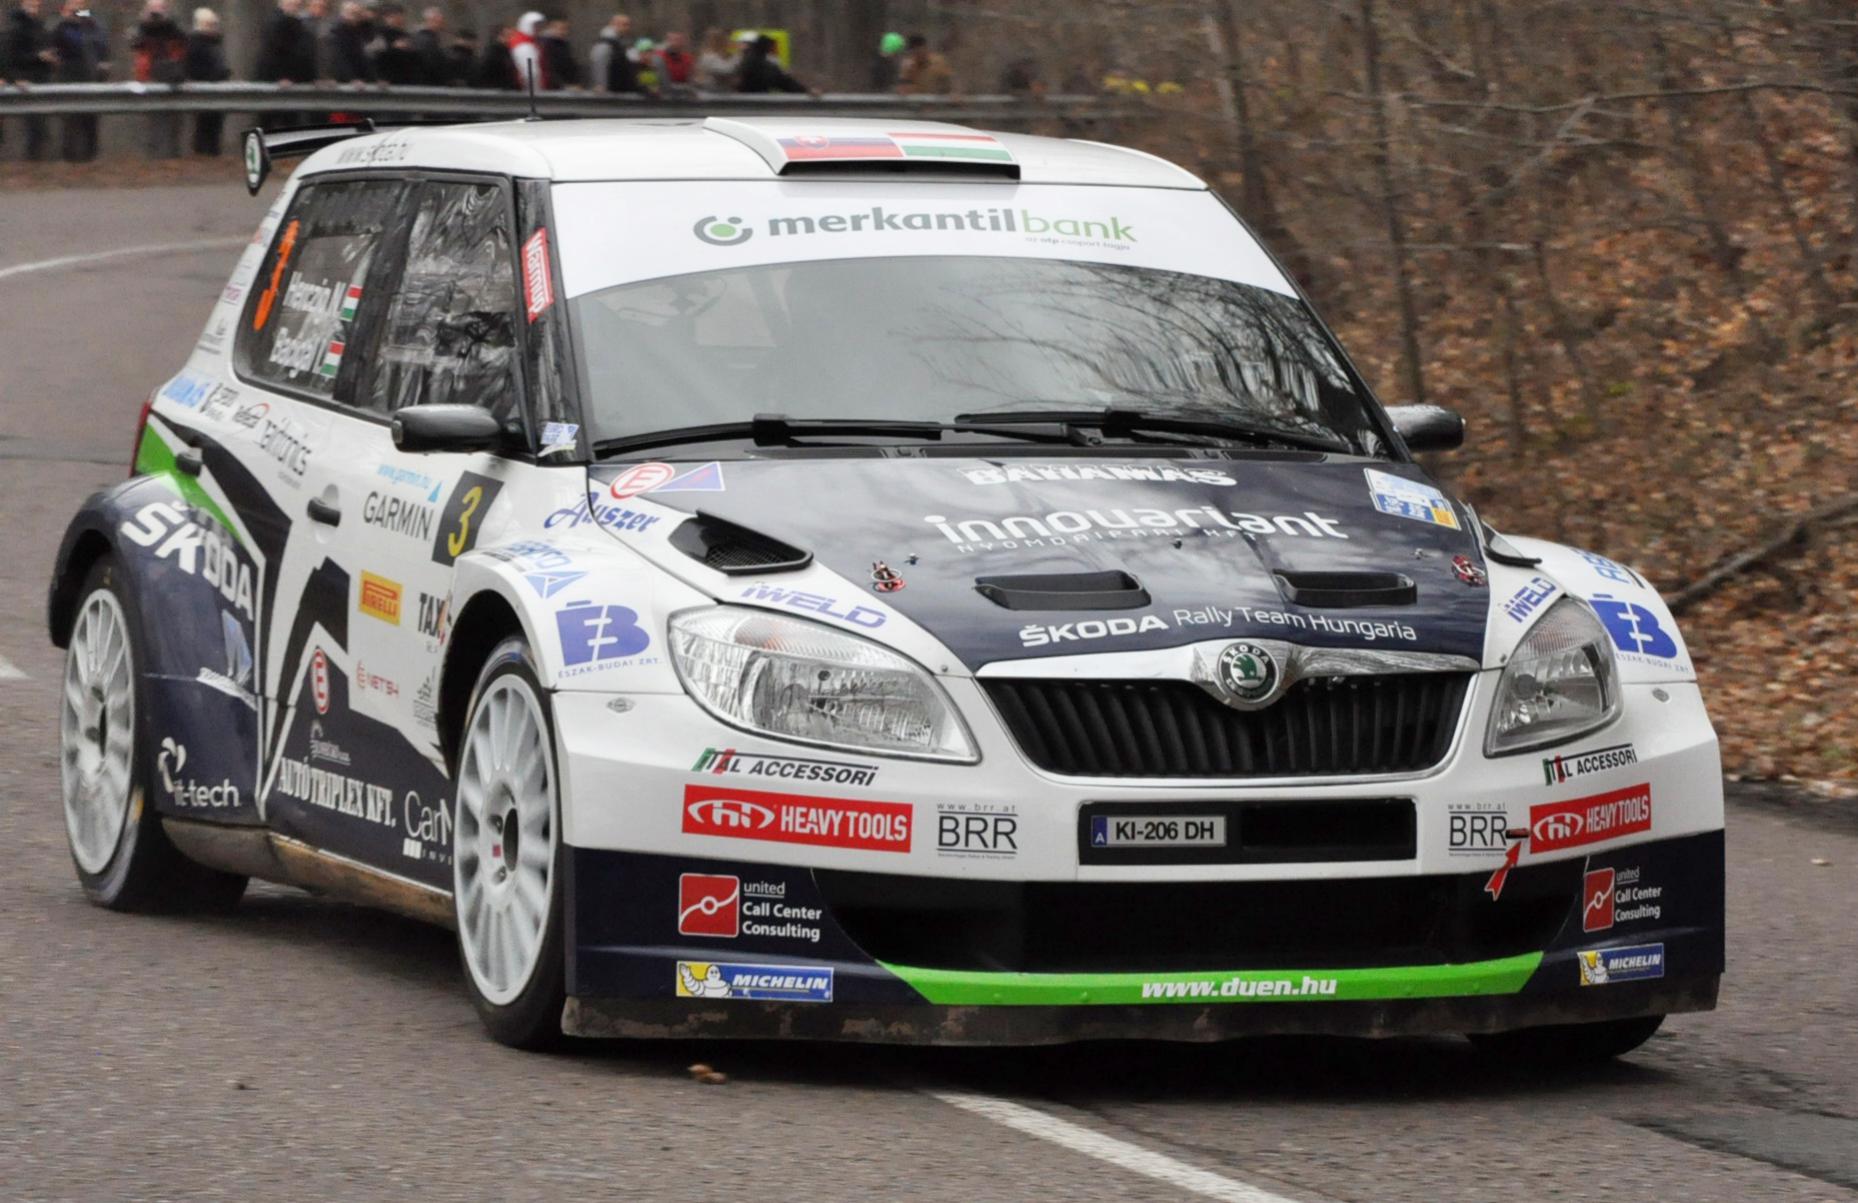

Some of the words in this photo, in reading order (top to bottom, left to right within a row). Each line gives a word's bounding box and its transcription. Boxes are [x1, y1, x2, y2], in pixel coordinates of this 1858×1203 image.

[958, 464, 1237, 486] BAHAMAS
[363, 490, 434, 541] GARMIN
[447, 486, 483, 557] 3
[1019, 614, 1169, 647] ŠKODA
[1173, 606, 1234, 627] Rally
[1235, 607, 1307, 629] Team
[1307, 613, 1417, 641] Hungaria
[278, 757, 365, 818] AUTÓTRIPLEX
[366, 783, 397, 828] KFT.
[781, 805, 846, 837] HEAVY
[846, 811, 908, 842] TOOLS
[1586, 806, 1617, 834] HEAVY
[1617, 794, 1649, 825] TOOLS
[938, 815, 1018, 850] BRR
[1115, 820, 1179, 842] KI-206
[1184, 820, 1215, 841] DH
[1450, 815, 1508, 848] BRR
[1616, 866, 1641, 881] united
[743, 881, 786, 896] united
[1615, 890, 1632, 903] Call
[1632, 886, 1662, 900] Center
[742, 902, 770, 917] Call
[772, 903, 822, 920] Center
[1615, 904, 1661, 922] Consulting
[742, 921, 821, 942] Consulting
[1608, 953, 1662, 971] MICHELIN
[732, 973, 829, 990] MICHELIN
[1142, 976, 1338, 999] www.duen.hu
